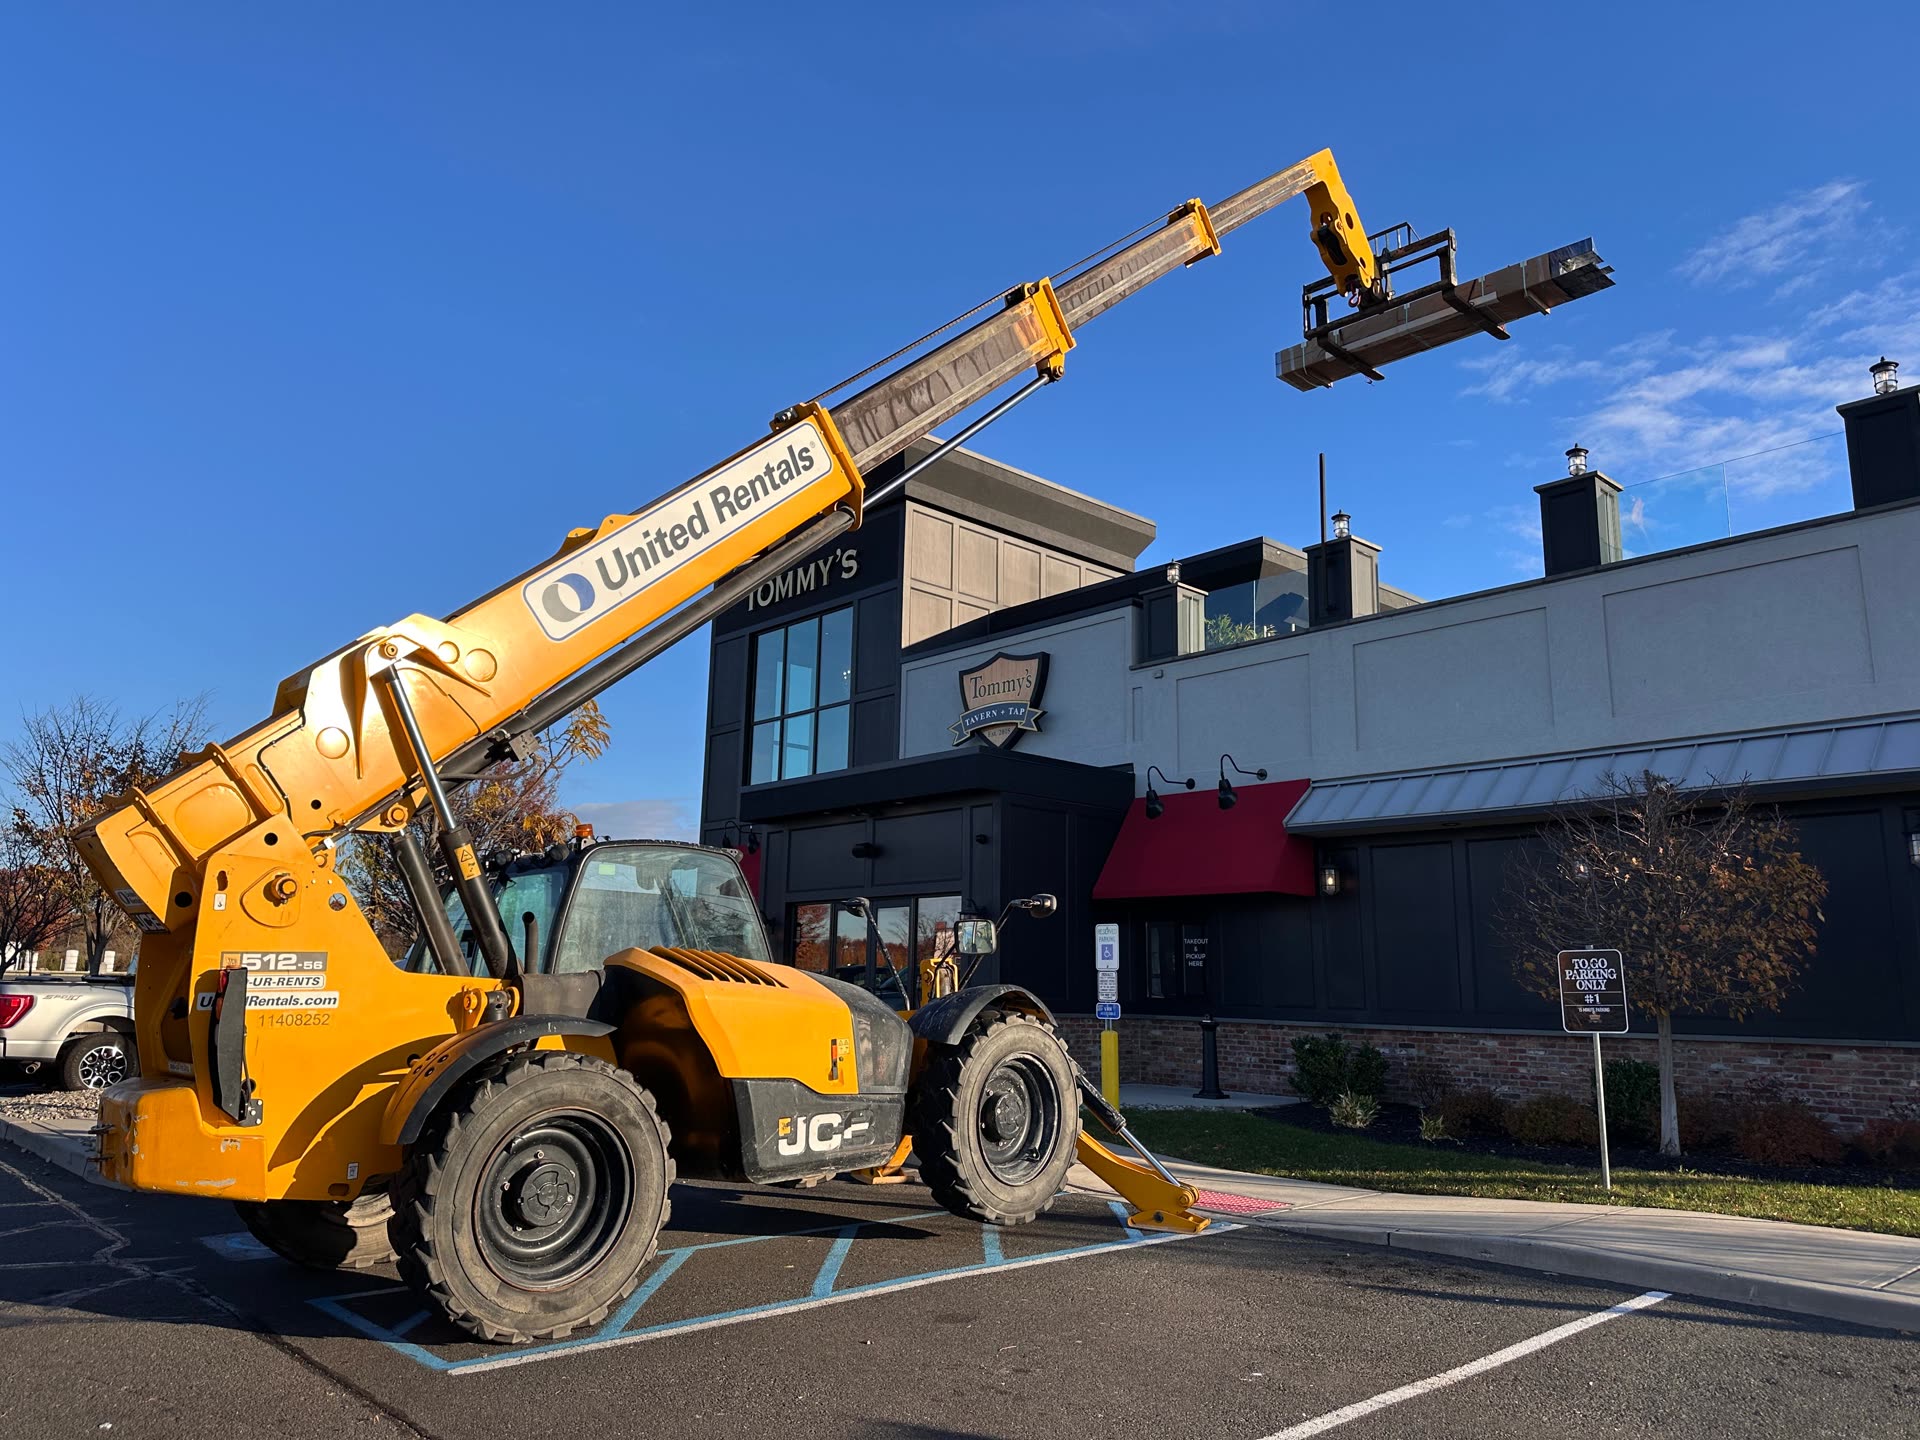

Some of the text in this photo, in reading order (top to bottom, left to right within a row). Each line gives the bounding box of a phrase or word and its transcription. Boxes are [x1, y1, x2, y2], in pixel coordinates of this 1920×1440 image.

[595, 443, 816, 592] United Rentals
[748, 548, 858, 612] TOMMY'S
[970, 669, 1032, 699] Tommy's
[965, 709, 998, 727] TAVERN
[1007, 707, 1026, 716] TAP
[242, 953, 323, 971] 512-56
[247, 976, 321, 987] -UR-RENTS
[1565, 969, 1617, 980] PARKING
[1576, 979, 1607, 990] ONLY
[199, 994, 338, 1008] URentals.com
[1584, 993, 1600, 1004] #1
[258, 1013, 331, 1028] 11408252
